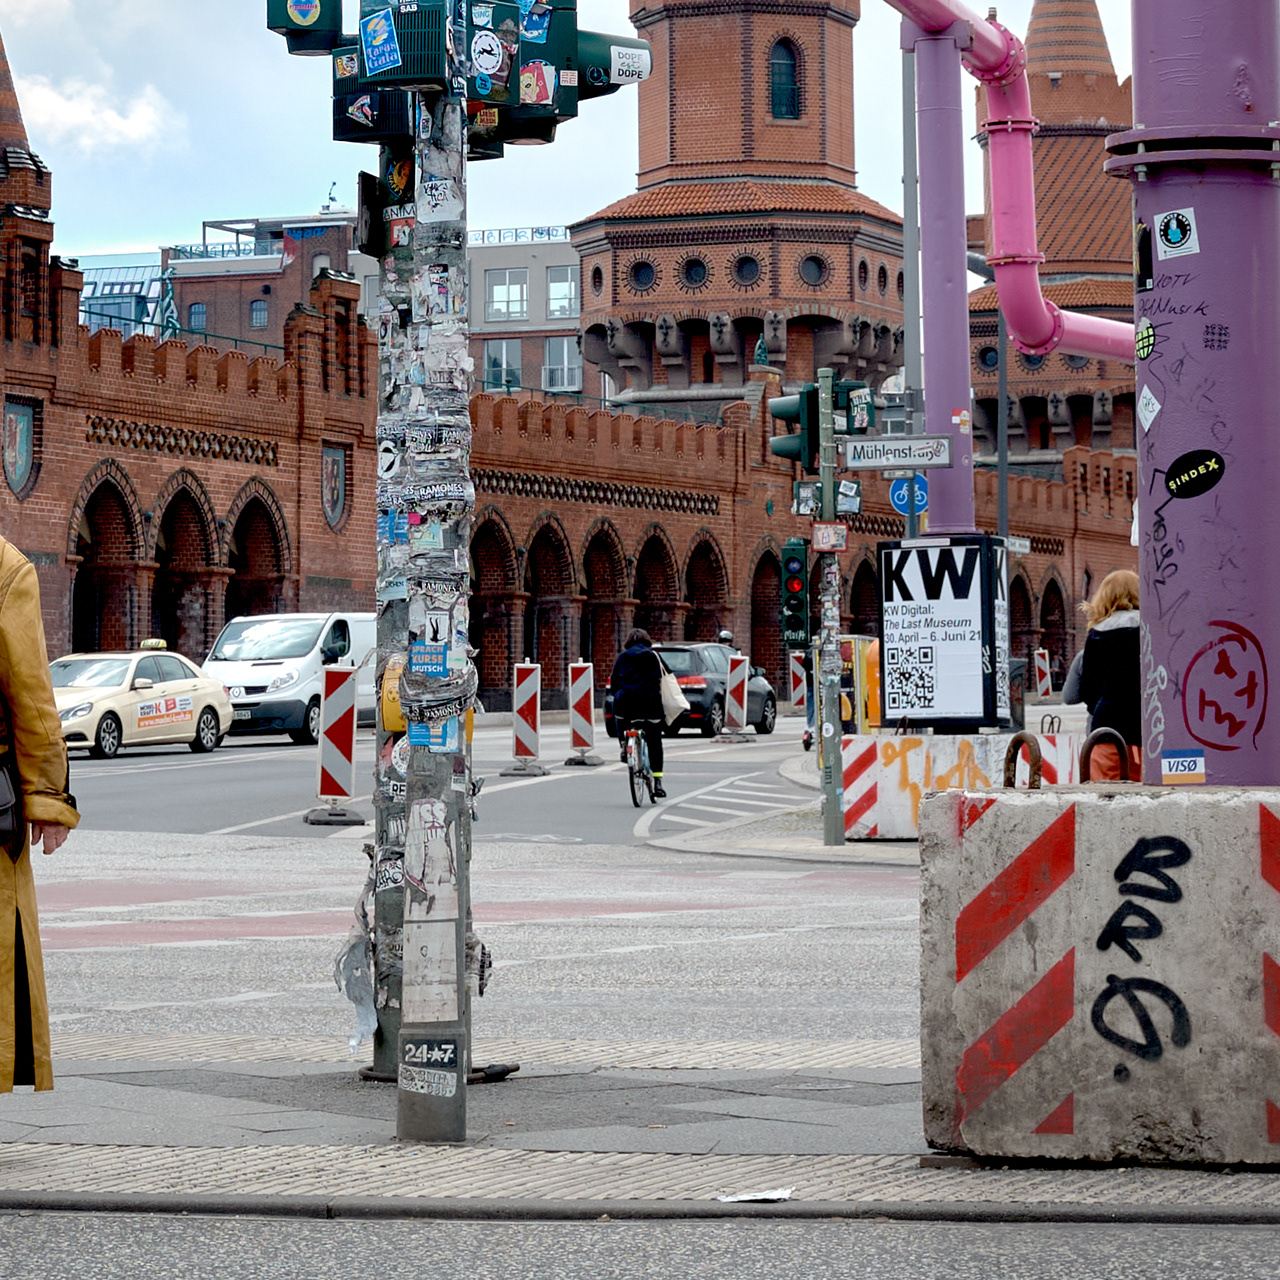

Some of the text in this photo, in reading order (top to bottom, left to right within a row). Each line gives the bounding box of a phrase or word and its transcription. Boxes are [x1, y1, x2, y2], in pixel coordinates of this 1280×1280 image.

[400, 4, 418, 13] SAB
[618, 69, 643, 79] DOPE
[1168, 457, 1219, 492] SINDEX
[420, 482, 463, 496] RAMONES
[884, 548, 980, 602] KW
[884, 604, 934, 617] KW Digital:
[885, 617, 971, 630] The Last Museum
[884, 632, 898, 643] 30.
[898, 631, 919, 644] April
[930, 631, 940, 641] 6.
[941, 630, 967, 641] Juni
[412, 654, 443, 664] KURSE
